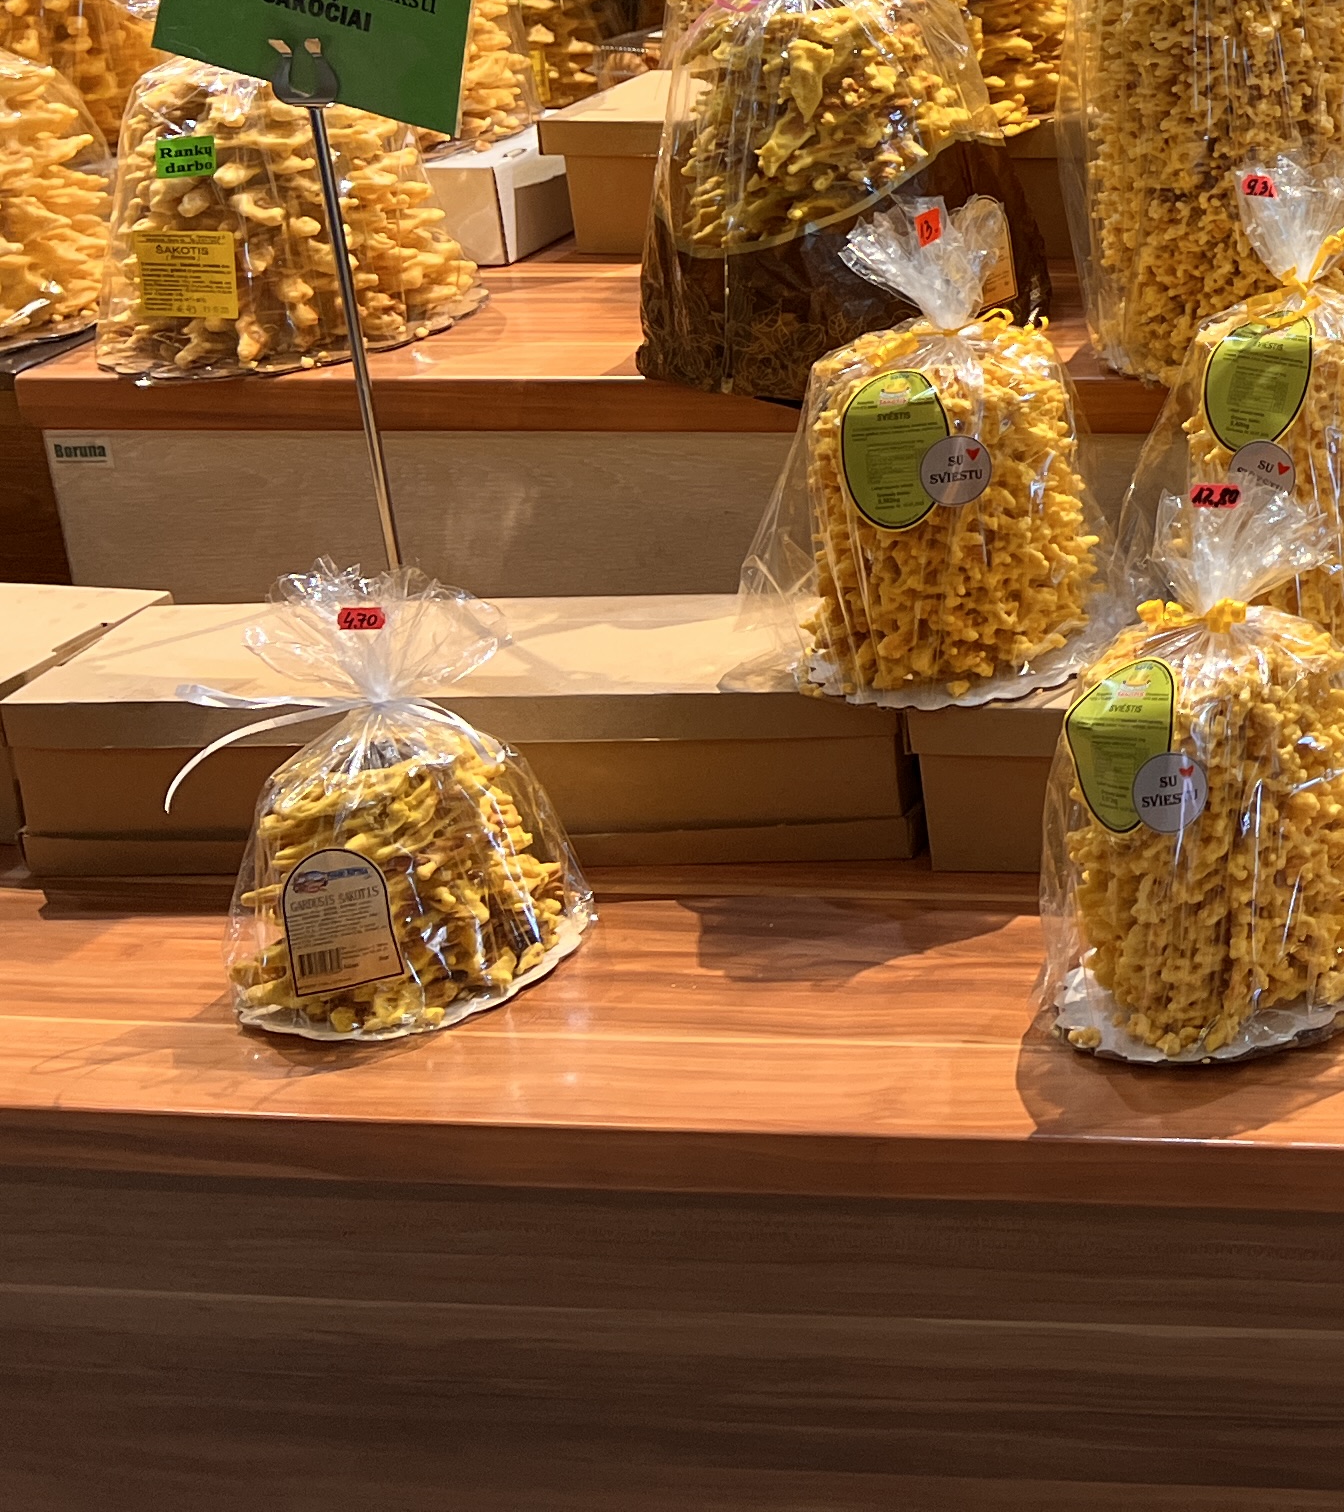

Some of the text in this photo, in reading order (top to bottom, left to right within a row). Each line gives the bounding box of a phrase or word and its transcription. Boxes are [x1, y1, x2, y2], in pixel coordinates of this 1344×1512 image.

[158, 144, 213, 159] Rankų
[164, 160, 214, 175] darbo
[155, 244, 210, 256] ŠAKOTIS
[53, 442, 107, 459] Boruna
[948, 454, 964, 467] SU
[1257, 459, 1275, 474] SU
[929, 469, 983, 485] SVIESTU
[342, 612, 379, 630] 4.70
[1159, 774, 1178, 788] SU
